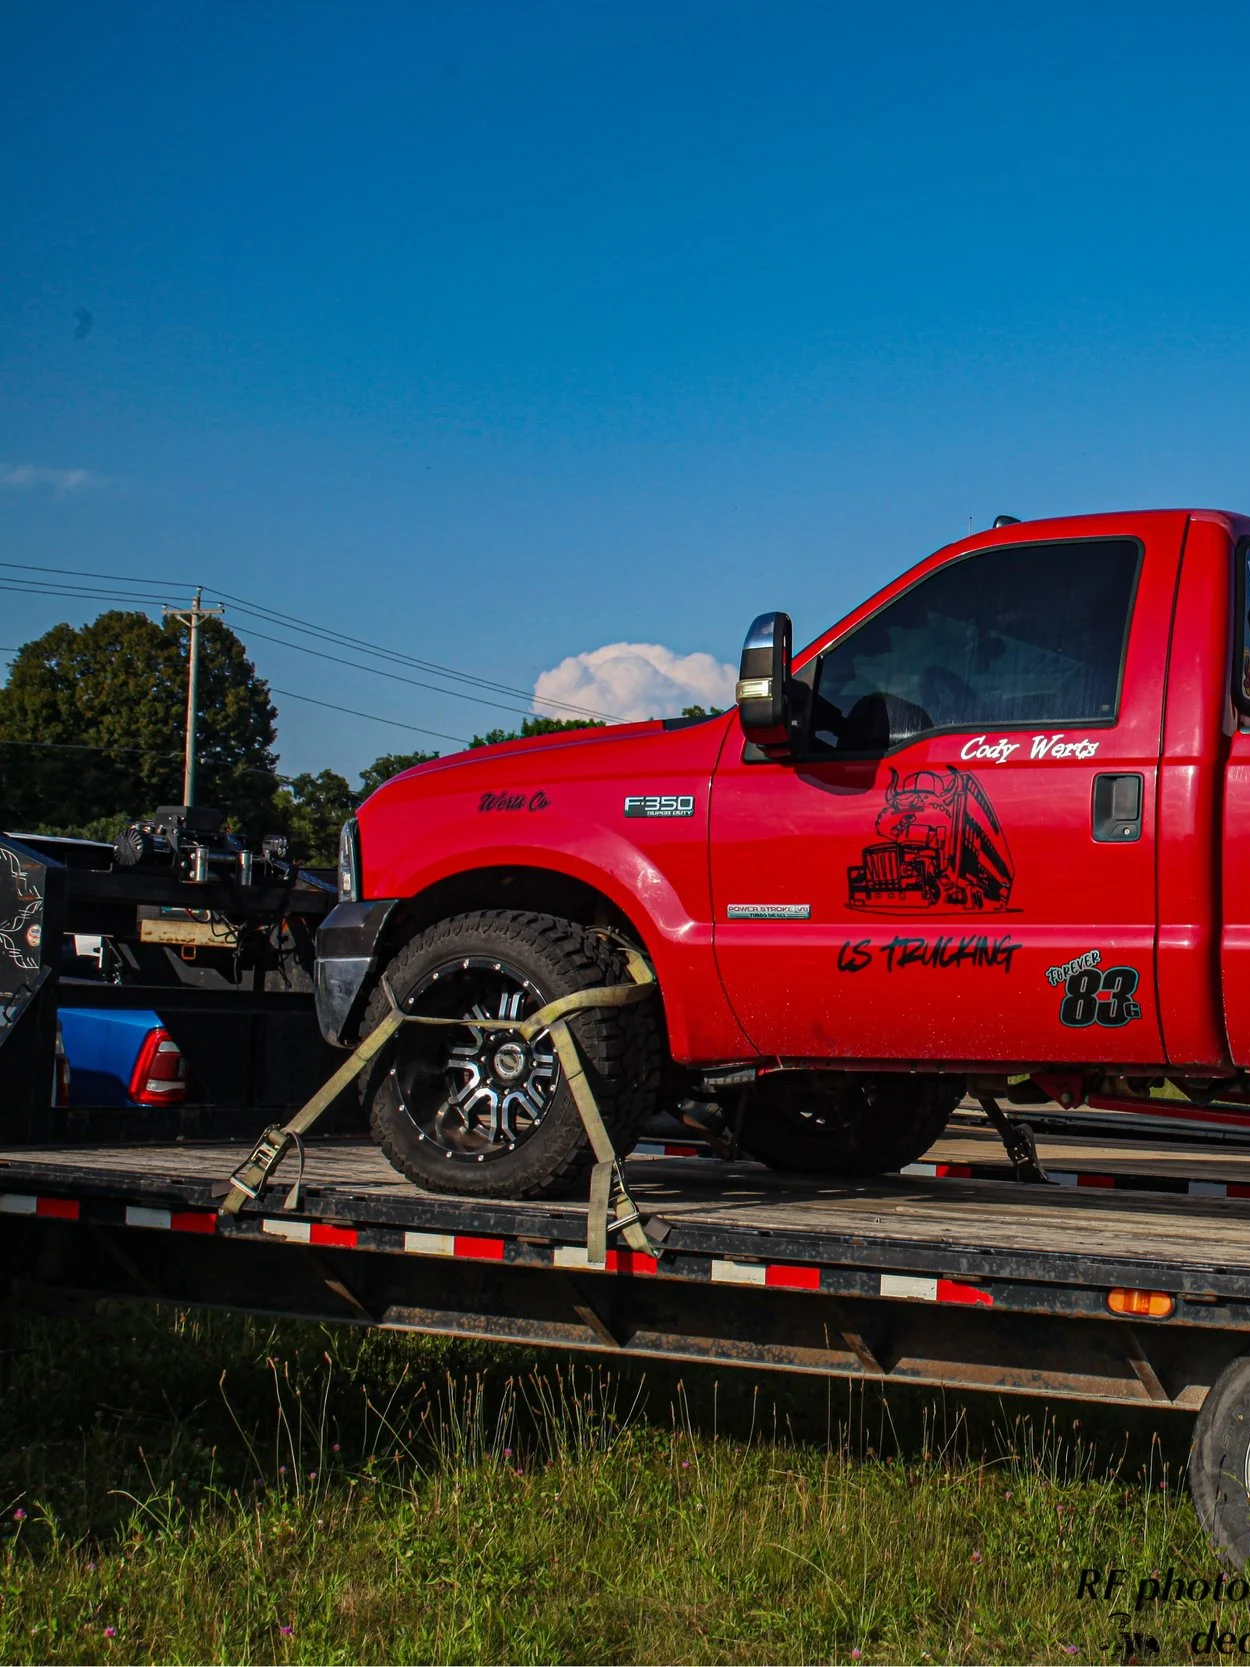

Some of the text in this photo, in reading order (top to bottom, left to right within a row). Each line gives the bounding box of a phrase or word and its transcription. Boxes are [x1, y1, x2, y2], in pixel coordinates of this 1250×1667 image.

[960, 734, 1100, 764] Cody Werts
[879, 935, 1023, 973] TRUCKING
[1046, 950, 1101, 987] FOREVER
[1060, 965, 1139, 1028] 83
